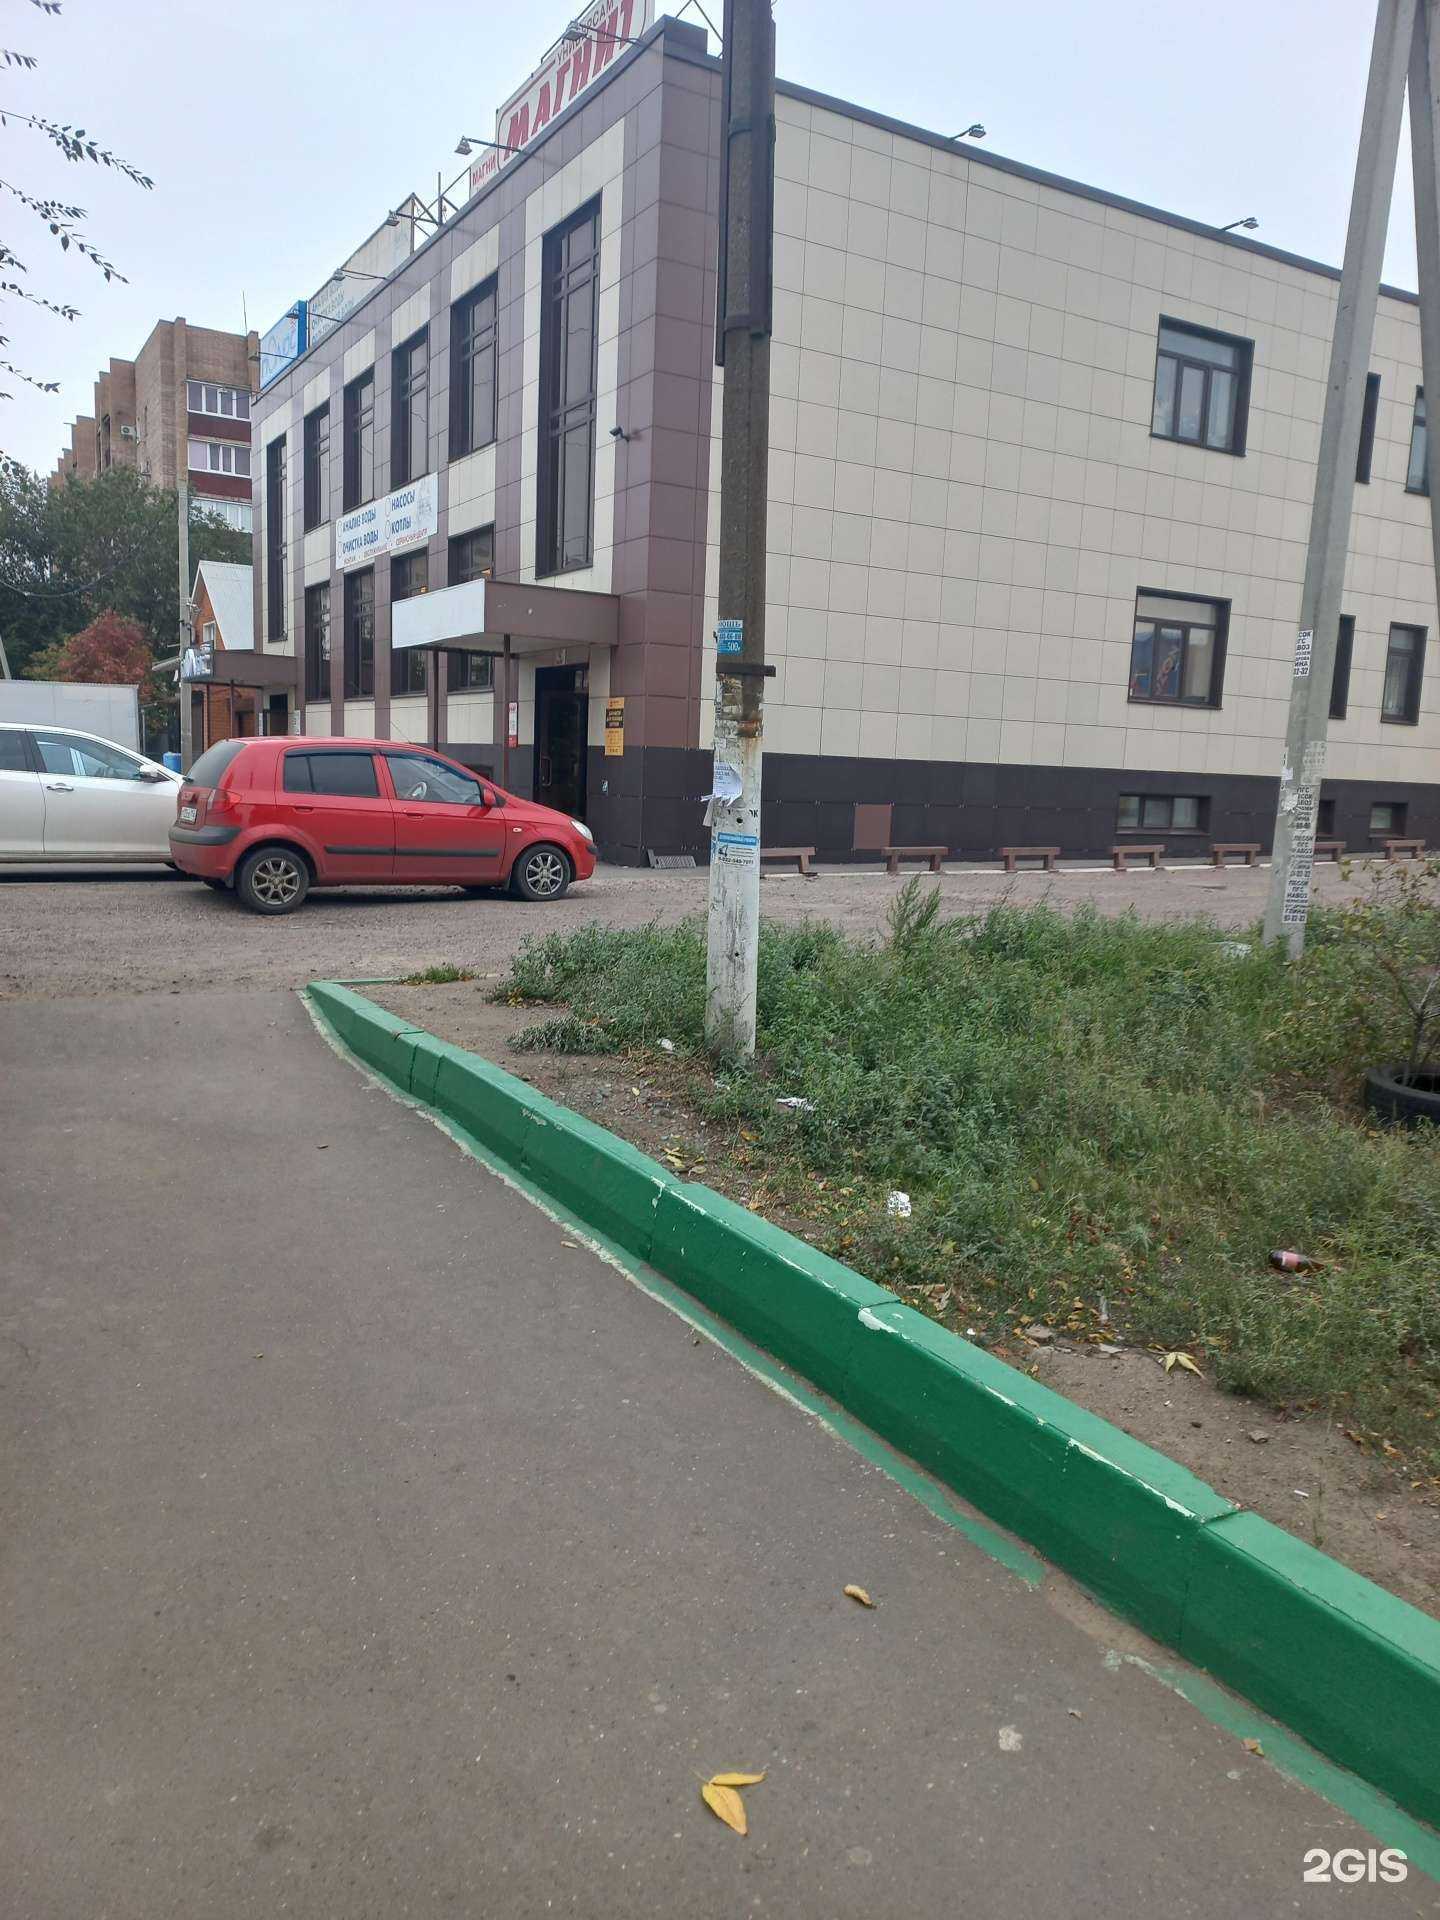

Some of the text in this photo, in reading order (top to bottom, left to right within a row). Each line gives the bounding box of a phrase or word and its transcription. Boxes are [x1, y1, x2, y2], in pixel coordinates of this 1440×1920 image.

[391, 489, 416, 511] НАСОСЫ
[343, 507, 377, 532] АНАЛИЗ ВОДЫ
[391, 516, 412, 534] КОТЛЫ
[342, 530, 379, 554] ОЧИСТКА ВОДЫ
